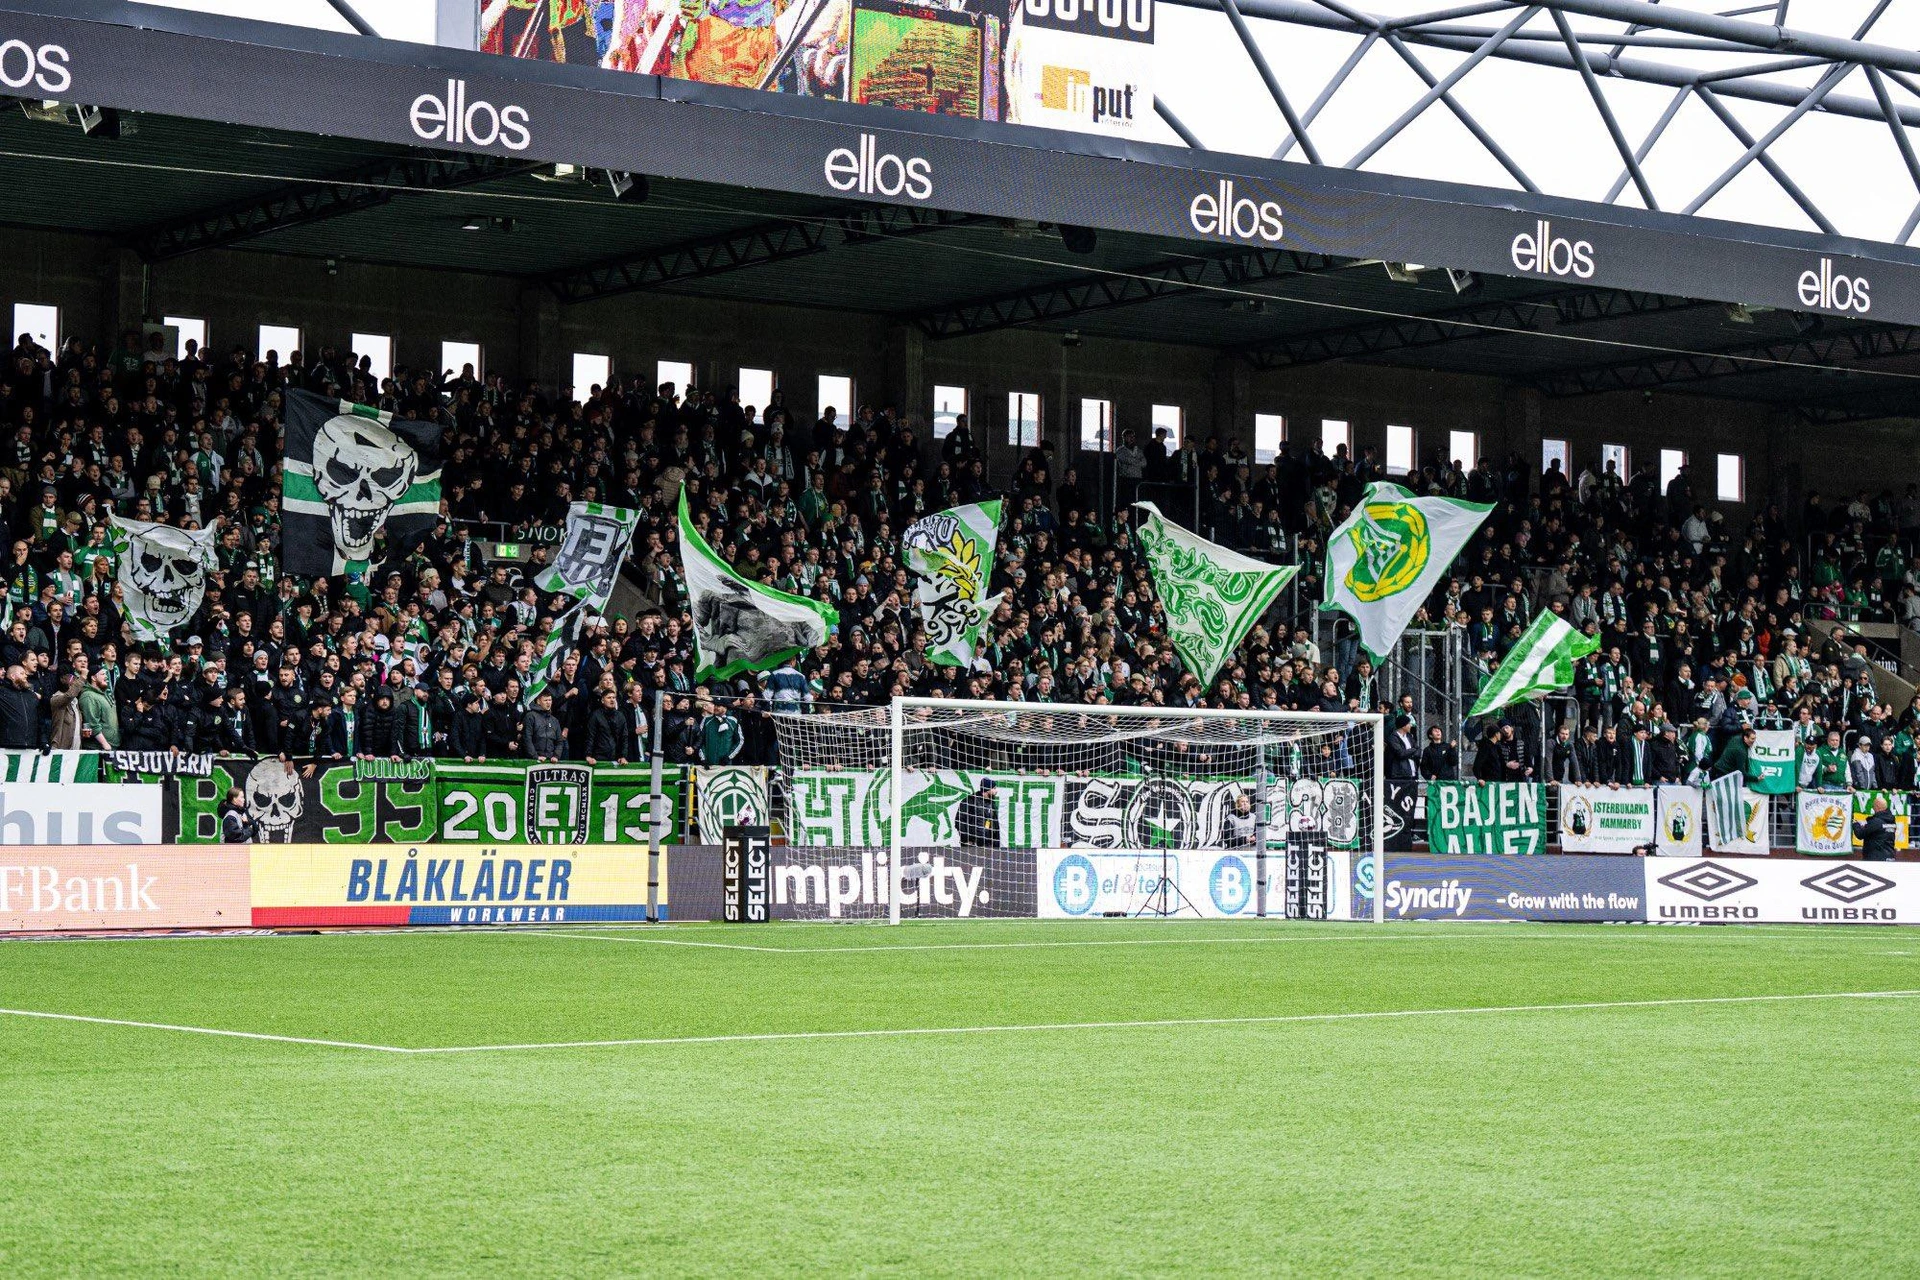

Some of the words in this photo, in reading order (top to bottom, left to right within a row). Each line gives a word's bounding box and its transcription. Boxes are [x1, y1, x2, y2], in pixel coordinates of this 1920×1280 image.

[409, 78, 530, 151] ellos
[824, 133, 933, 200] ellos
[1190, 180, 1284, 242] ellos
[1511, 220, 1595, 279] ellos
[1797, 258, 1871, 313] ellos
[115, 749, 213, 778] SPJUVERN
[532, 769, 587, 783] ULTRAS
[318, 764, 438, 845] 99
[1440, 782, 1540, 829] BAJEN
[1599, 817, 1643, 830] HAMMARBY
[346, 848, 572, 903] BLÅKLÄDER
[725, 838, 740, 921] SELECT
[747, 838, 766, 921] SELECT
[769, 851, 990, 918] mplicity.
[1286, 842, 1300, 919] SELECT
[1307, 843, 1325, 919] SELECT
[1385, 879, 1473, 917] Syncify
[1548, 892, 1580, 909] with
[1582, 892, 1605, 909] the
[1608, 892, 1639, 909] flow
[450, 907, 566, 922] WORKWEAR
